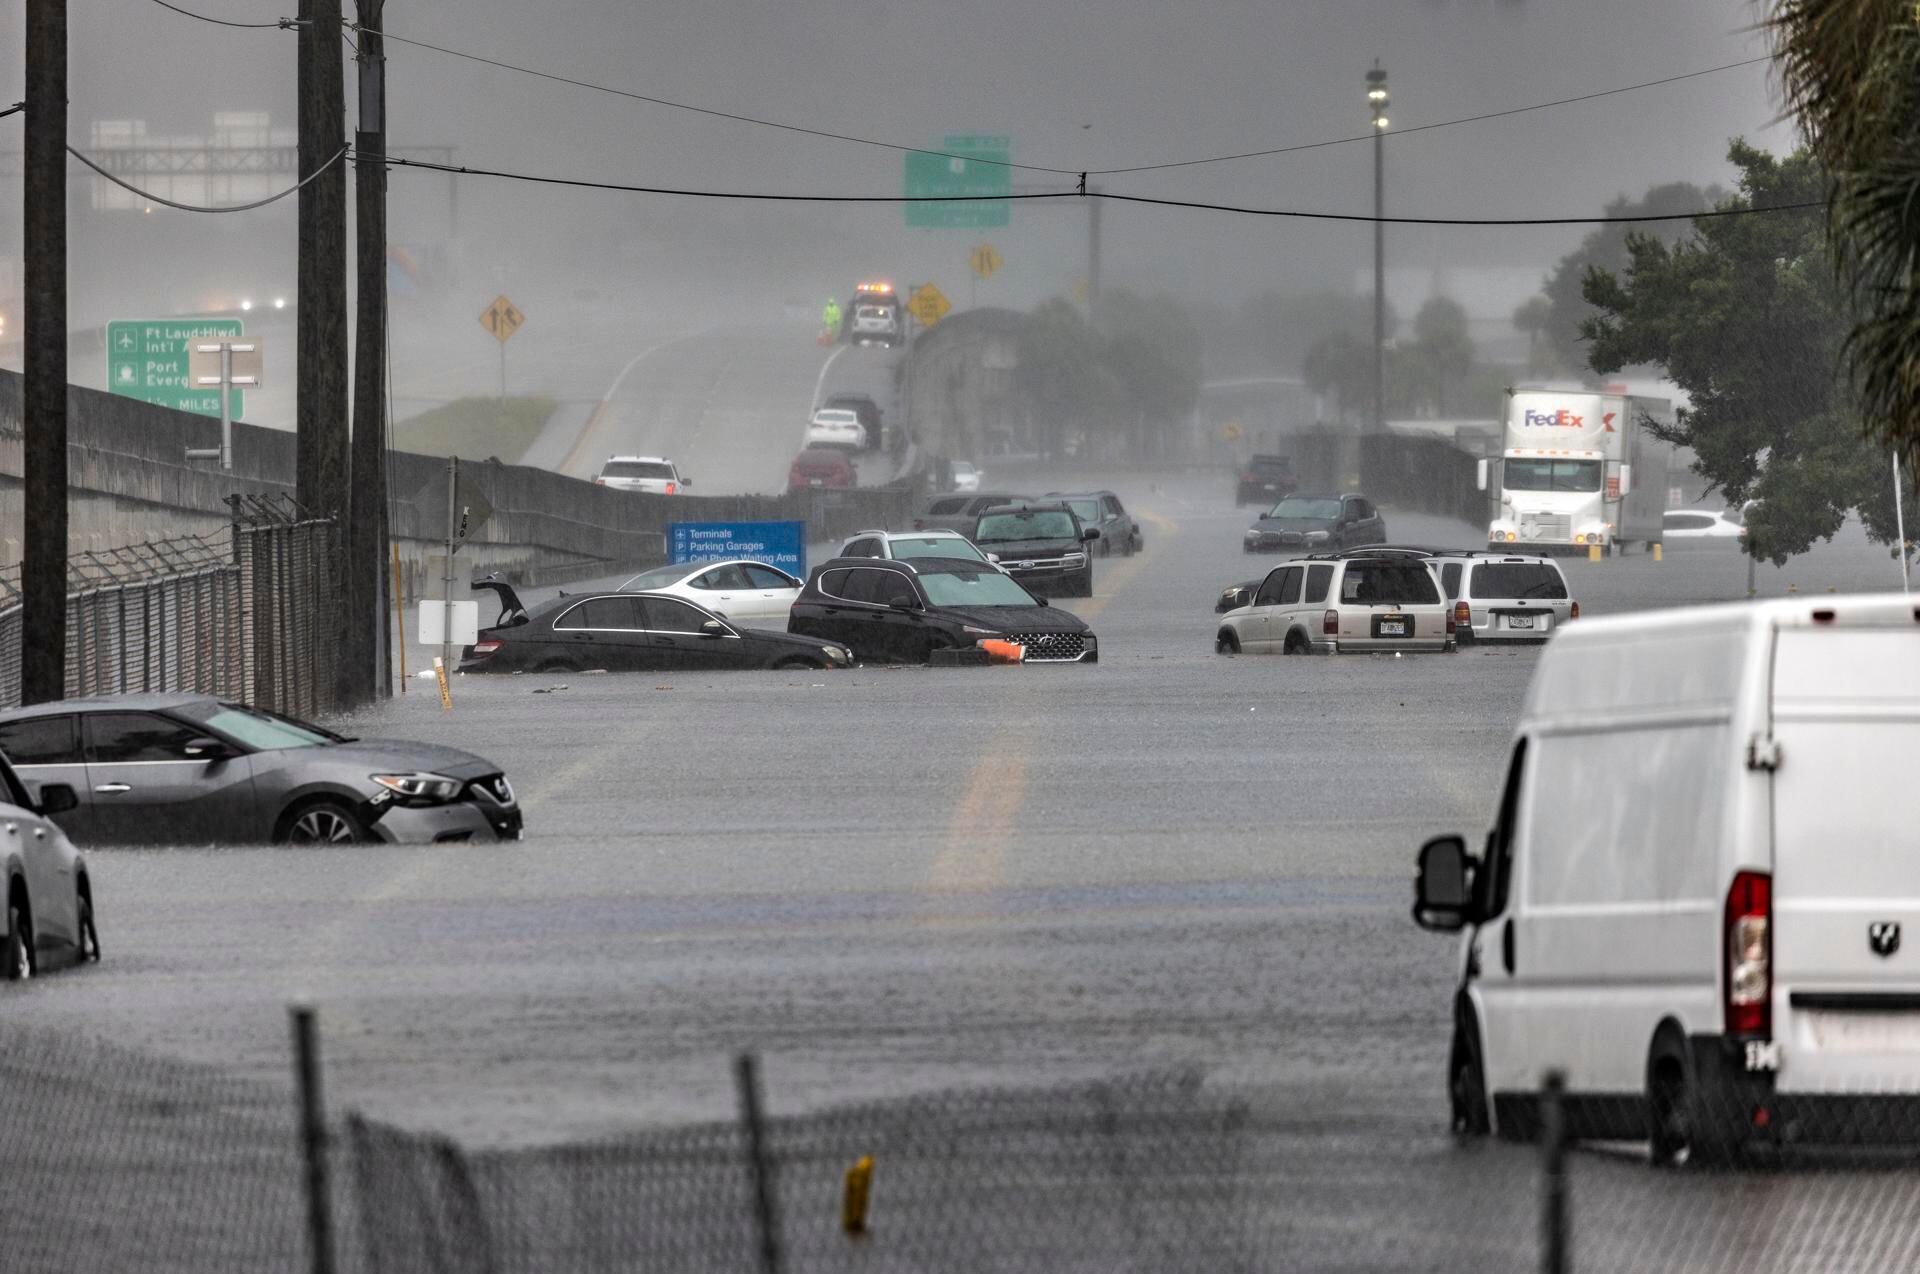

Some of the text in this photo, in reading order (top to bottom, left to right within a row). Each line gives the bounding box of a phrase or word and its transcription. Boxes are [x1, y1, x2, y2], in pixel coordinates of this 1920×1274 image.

[146, 327, 160, 339] Ft
[146, 341, 174, 353] Int'l
[147, 360, 178, 371] Port
[147, 375, 189, 388] Everg
[179, 399, 219, 410] MILES
[1525, 409, 1584, 428] FedEx
[690, 529, 733, 539] Terminals
[690, 541, 724, 553] Parking
[726, 541, 764, 553] Garages
[690, 554, 708, 562] Cell
[741, 553, 774, 564] Waiting
[776, 553, 797, 562] Area
